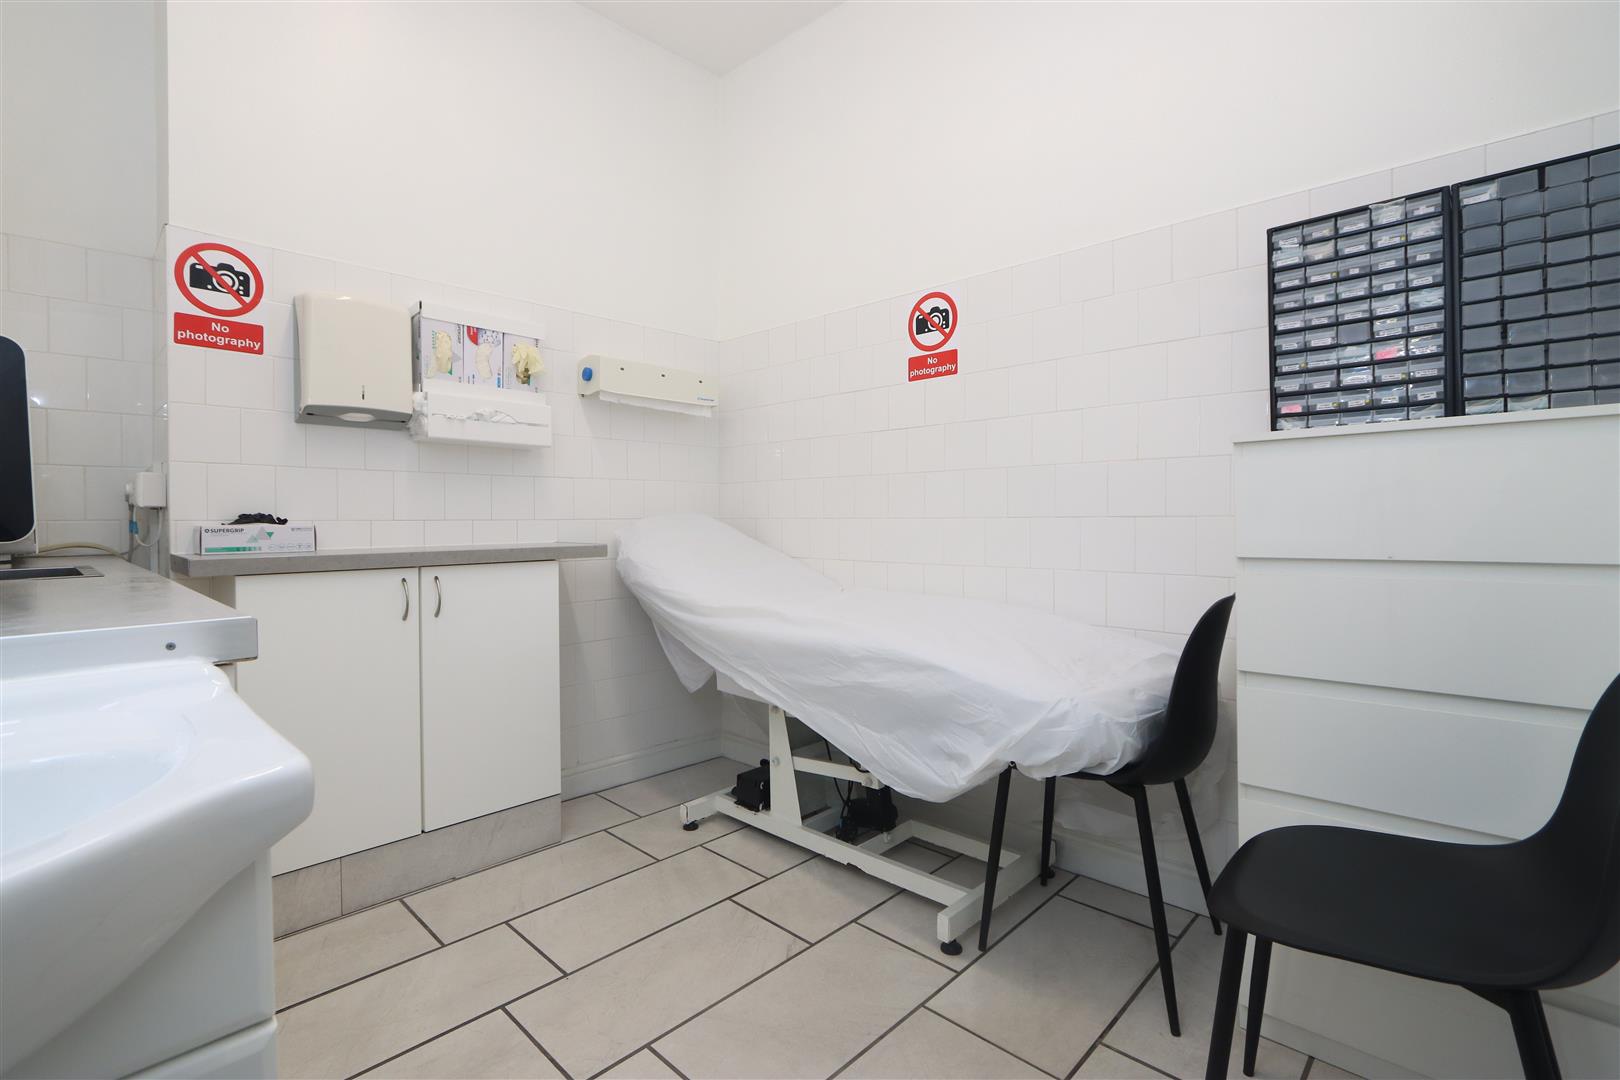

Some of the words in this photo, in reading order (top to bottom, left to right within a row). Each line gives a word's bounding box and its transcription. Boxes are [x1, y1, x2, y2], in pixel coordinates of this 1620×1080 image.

[211, 322, 230, 333] No
[177, 330, 261, 350] photography
[927, 356, 938, 365] No
[910, 363, 956, 379] photography
